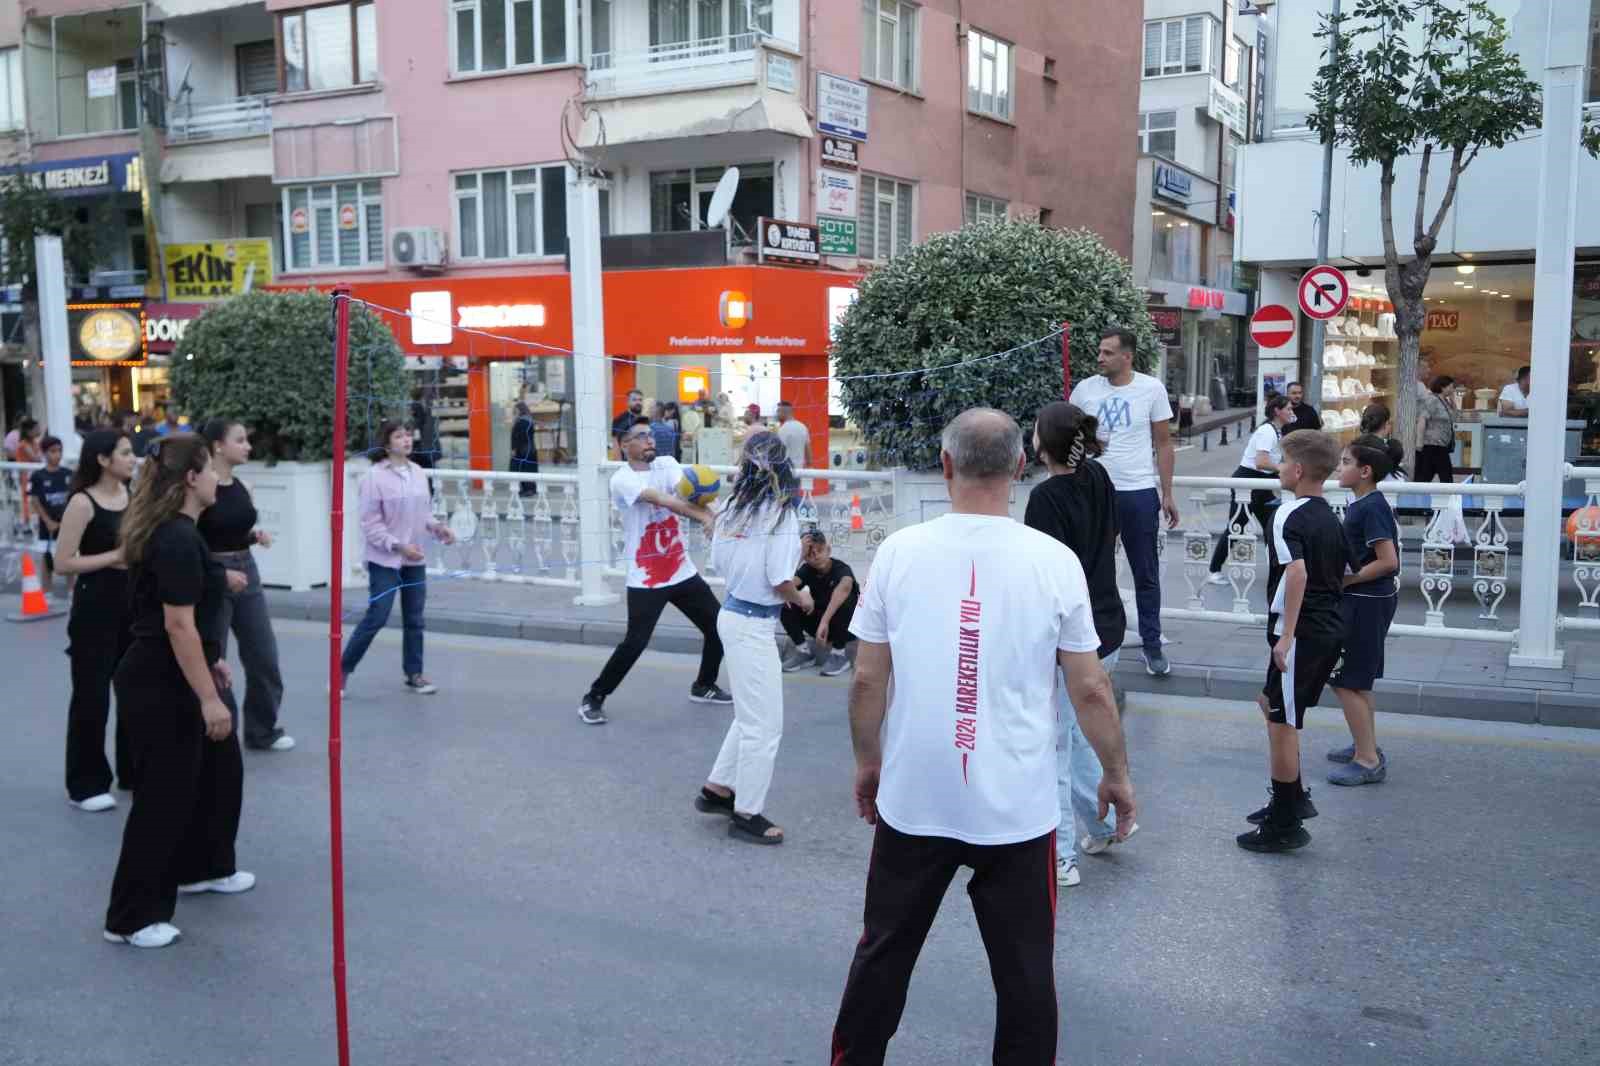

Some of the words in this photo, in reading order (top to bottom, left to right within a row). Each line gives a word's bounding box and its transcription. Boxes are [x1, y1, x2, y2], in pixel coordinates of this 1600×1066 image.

[45, 160, 108, 189] MERKEZİ
[819, 219, 854, 234] FOTO
[168, 244, 235, 283] EKİN
[175, 285, 233, 297] EMLAK
[669, 335, 709, 346] Preferred
[710, 335, 744, 346] Partner
[959, 599, 982, 623] YILI
[955, 717, 977, 750] 2024
